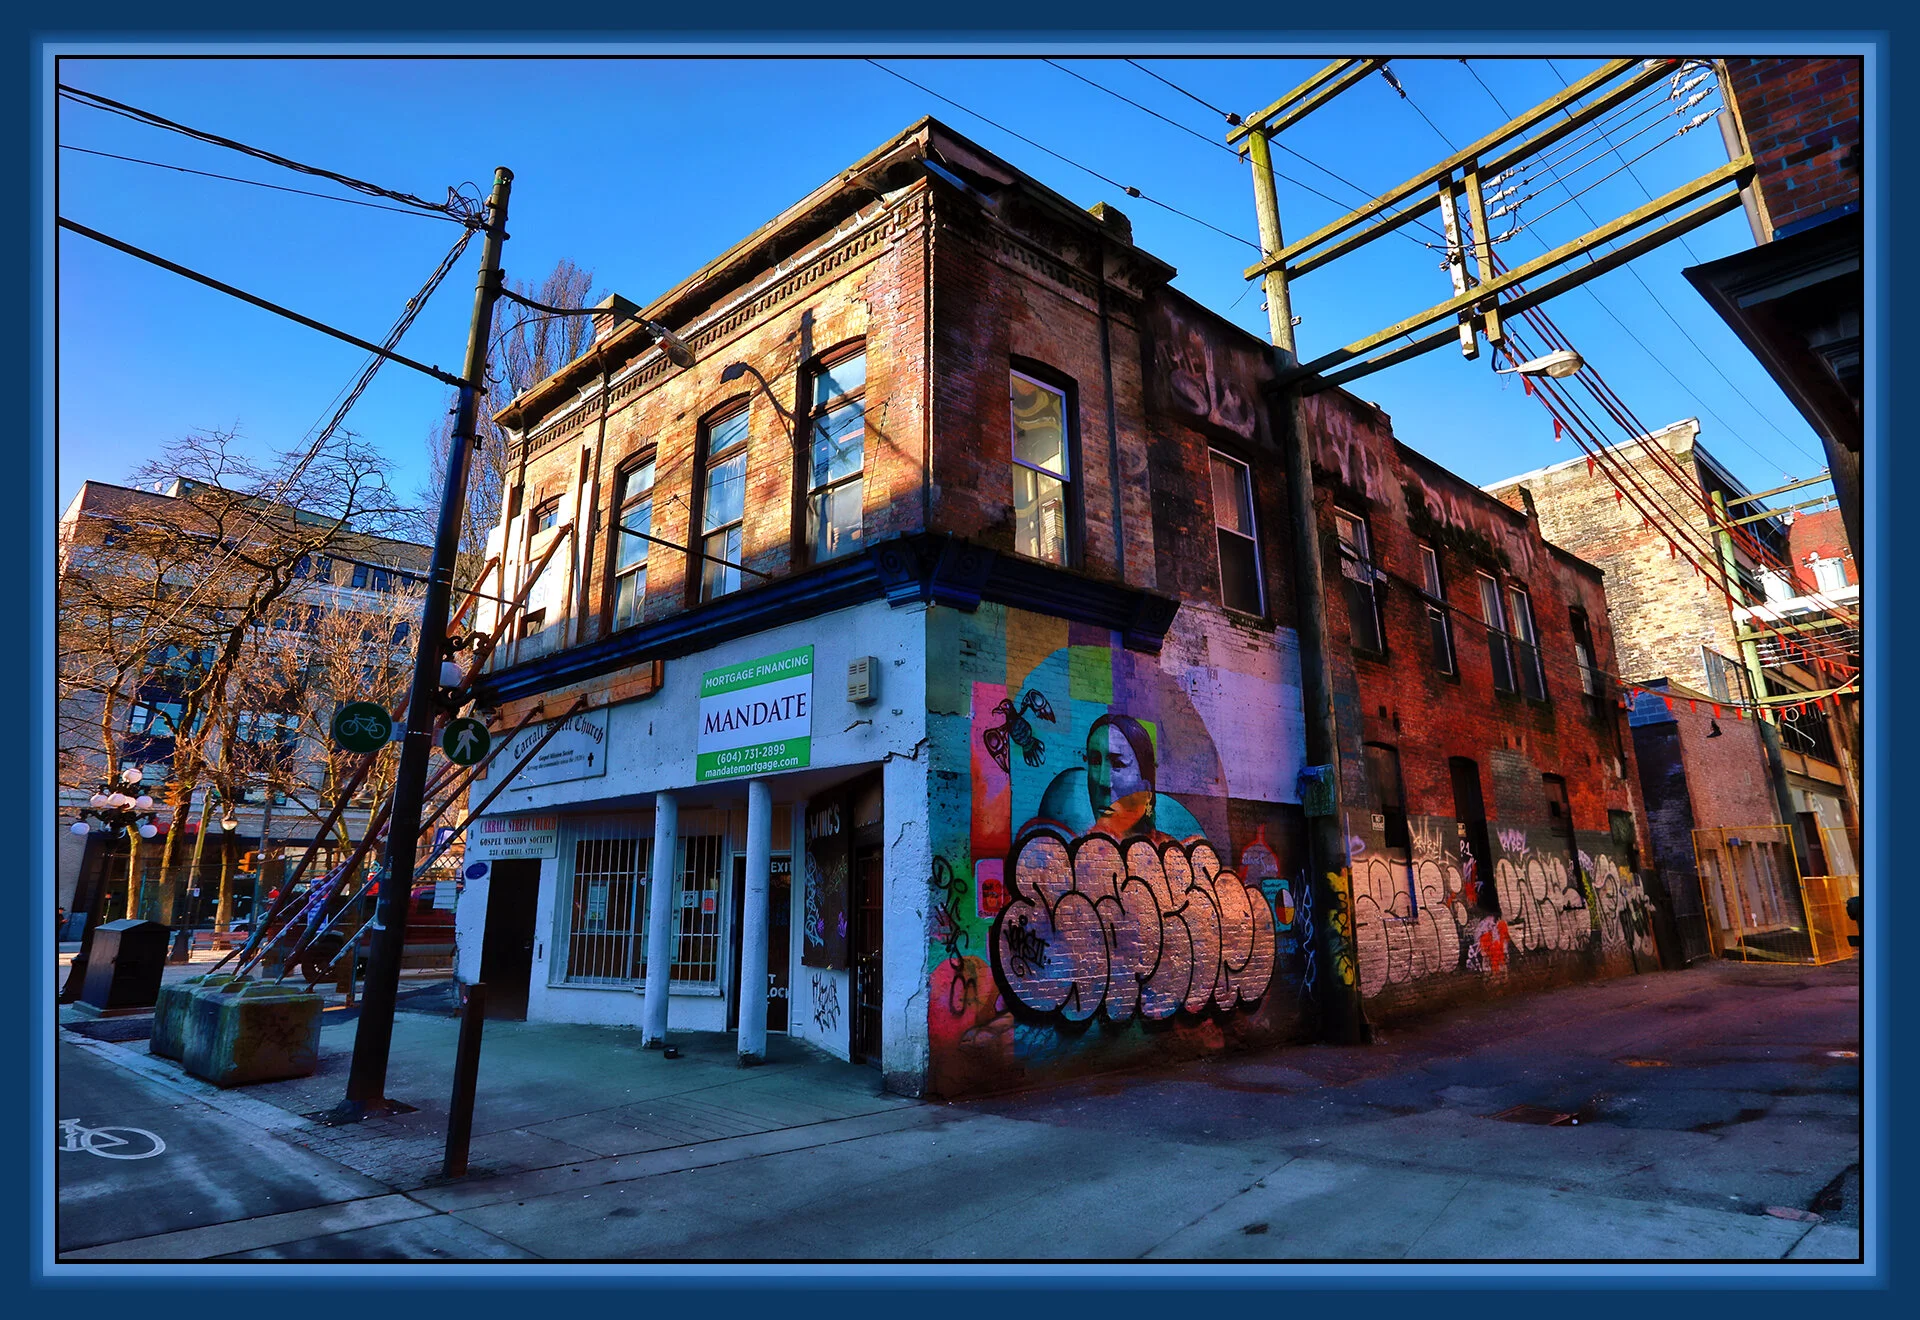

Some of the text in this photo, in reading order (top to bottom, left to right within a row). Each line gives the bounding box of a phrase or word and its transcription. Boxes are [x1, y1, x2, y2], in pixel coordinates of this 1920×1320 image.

[705, 654, 809, 688] MORTGAGE FINANCING
[703, 692, 807, 735] MANDATE
[513, 724, 544, 760] Carrall
[574, 715, 604, 745] Church
[705, 756, 799, 777] mandatemortgage.com
[717, 743, 786, 766] (604) 731-2899
[480, 835, 553, 846] GOSPEL MISSION SOCIETY
